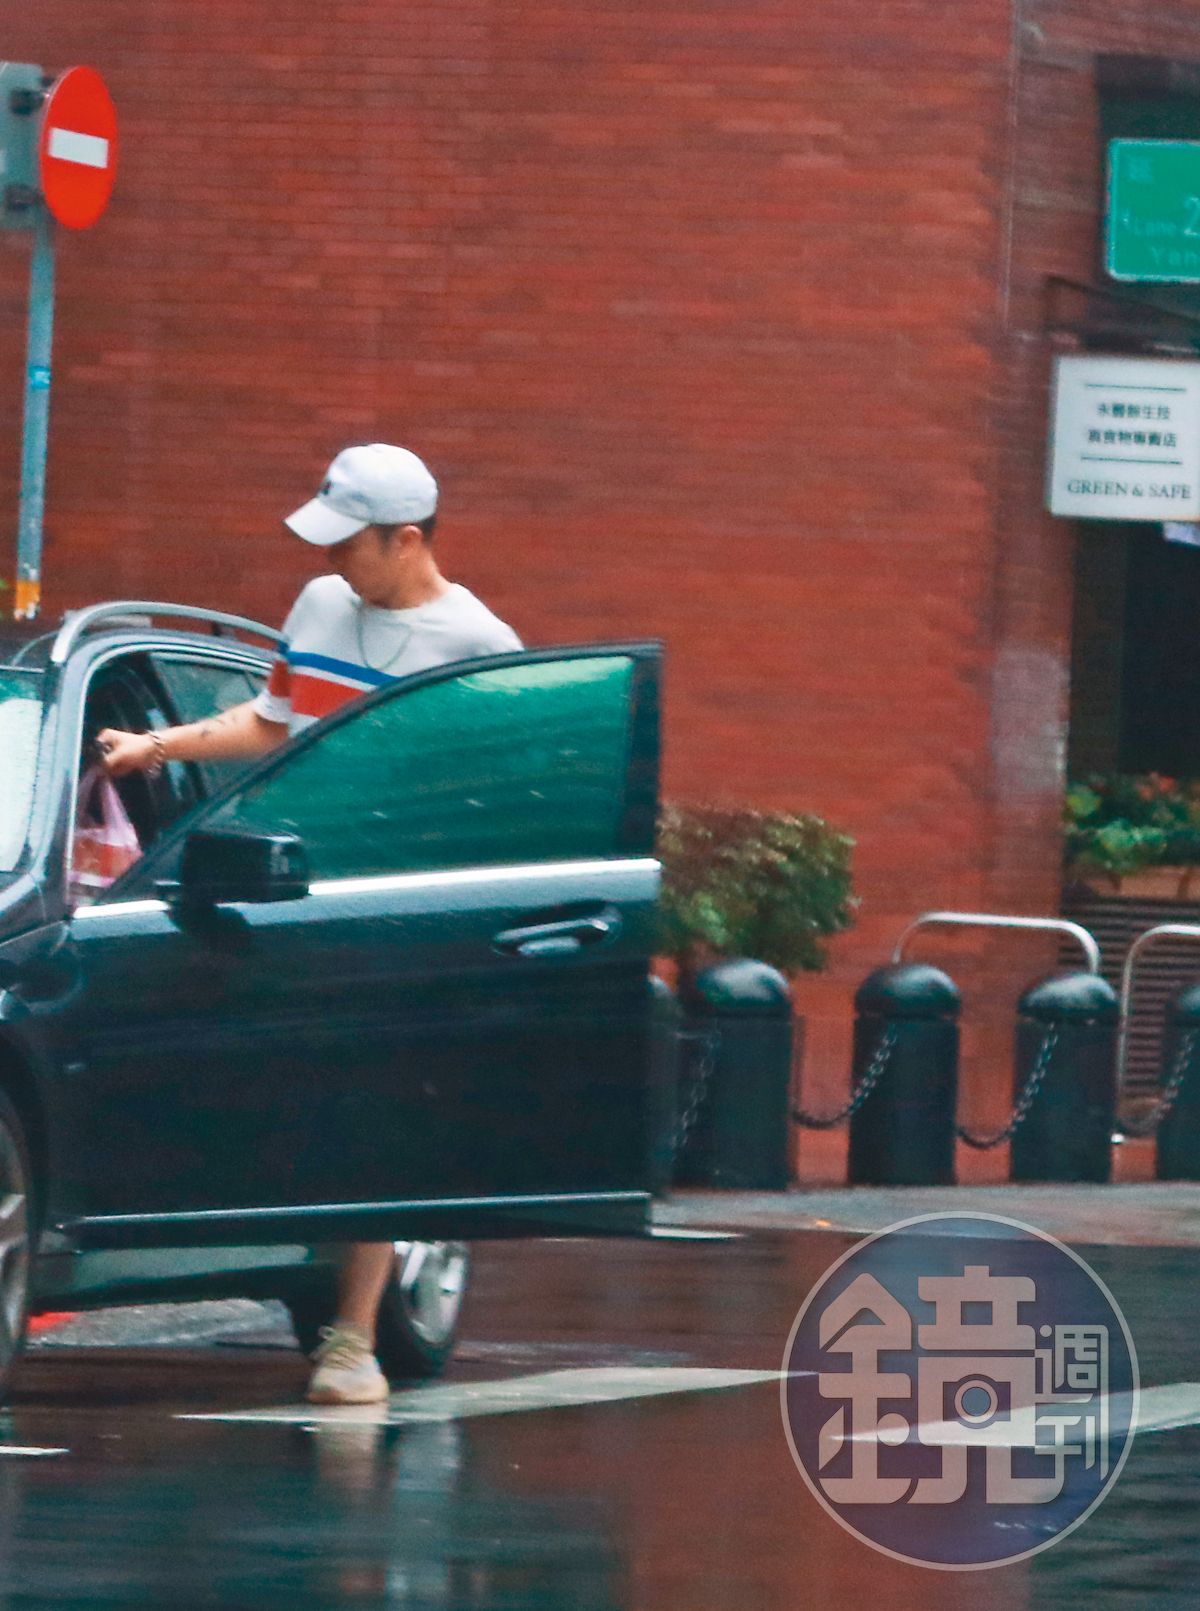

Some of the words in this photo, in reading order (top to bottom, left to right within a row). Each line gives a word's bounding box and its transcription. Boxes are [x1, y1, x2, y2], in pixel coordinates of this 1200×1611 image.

[1067, 479, 1128, 495] GREEN
[1132, 484, 1143, 497] &
[1149, 483, 1191, 499] SAFE
